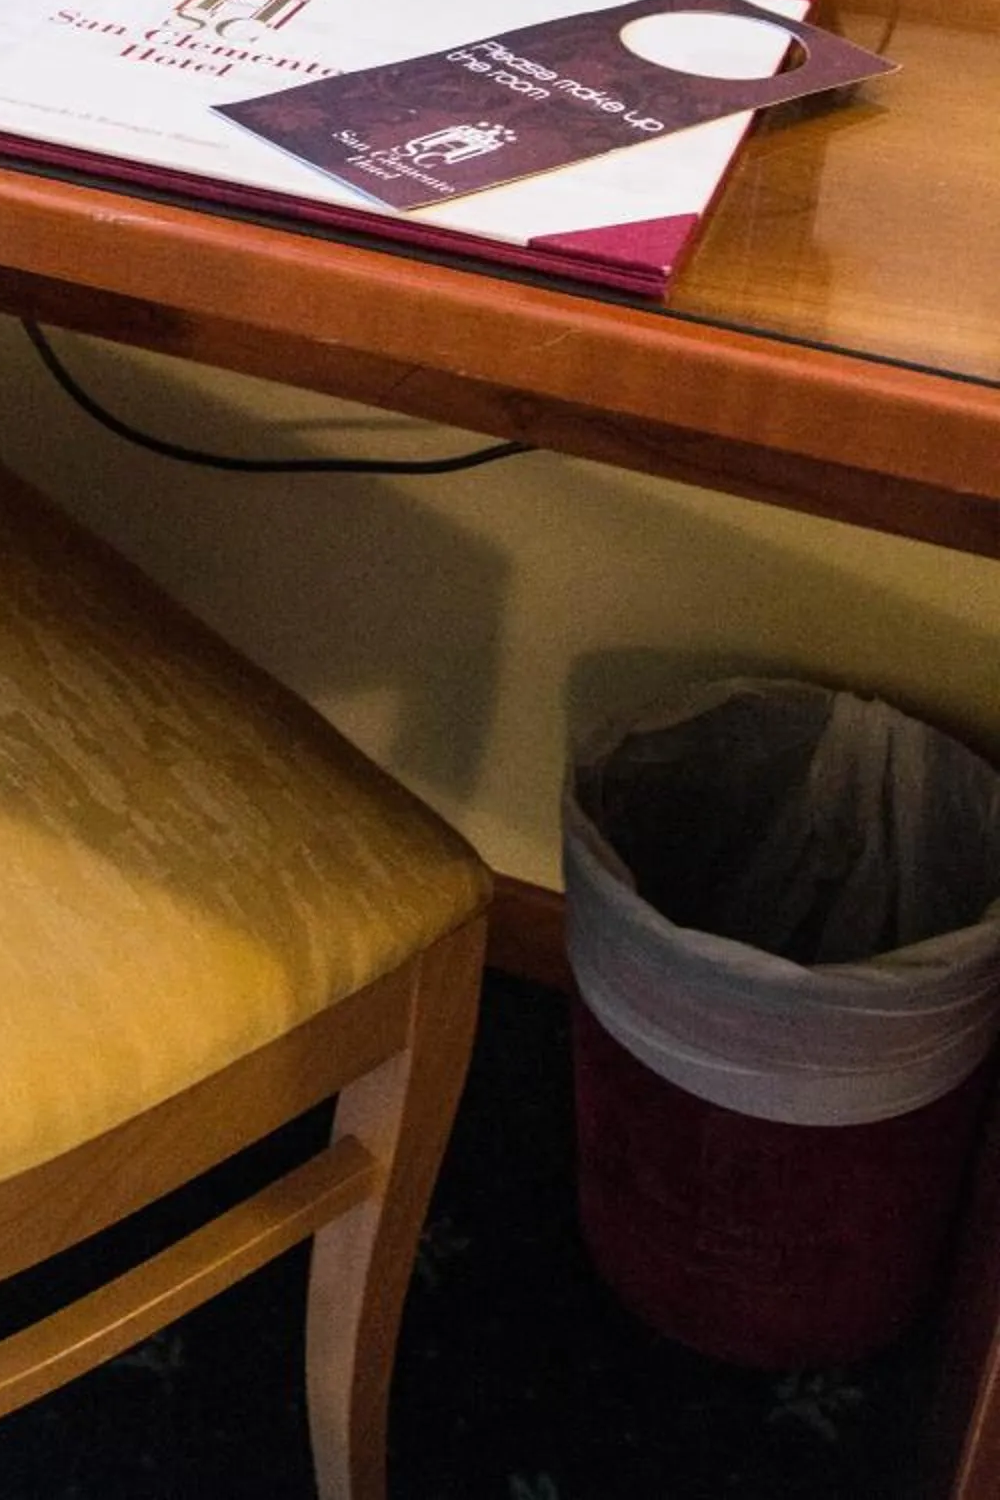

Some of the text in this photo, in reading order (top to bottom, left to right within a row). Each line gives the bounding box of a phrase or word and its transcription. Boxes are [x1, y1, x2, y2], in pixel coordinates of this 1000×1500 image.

[49, 8, 344, 77] San Clemente
[119, 43, 234, 78] Hotel
[446, 49, 550, 100] the room
[472, 41, 664, 132] Please make up
[331, 129, 371, 151] San
